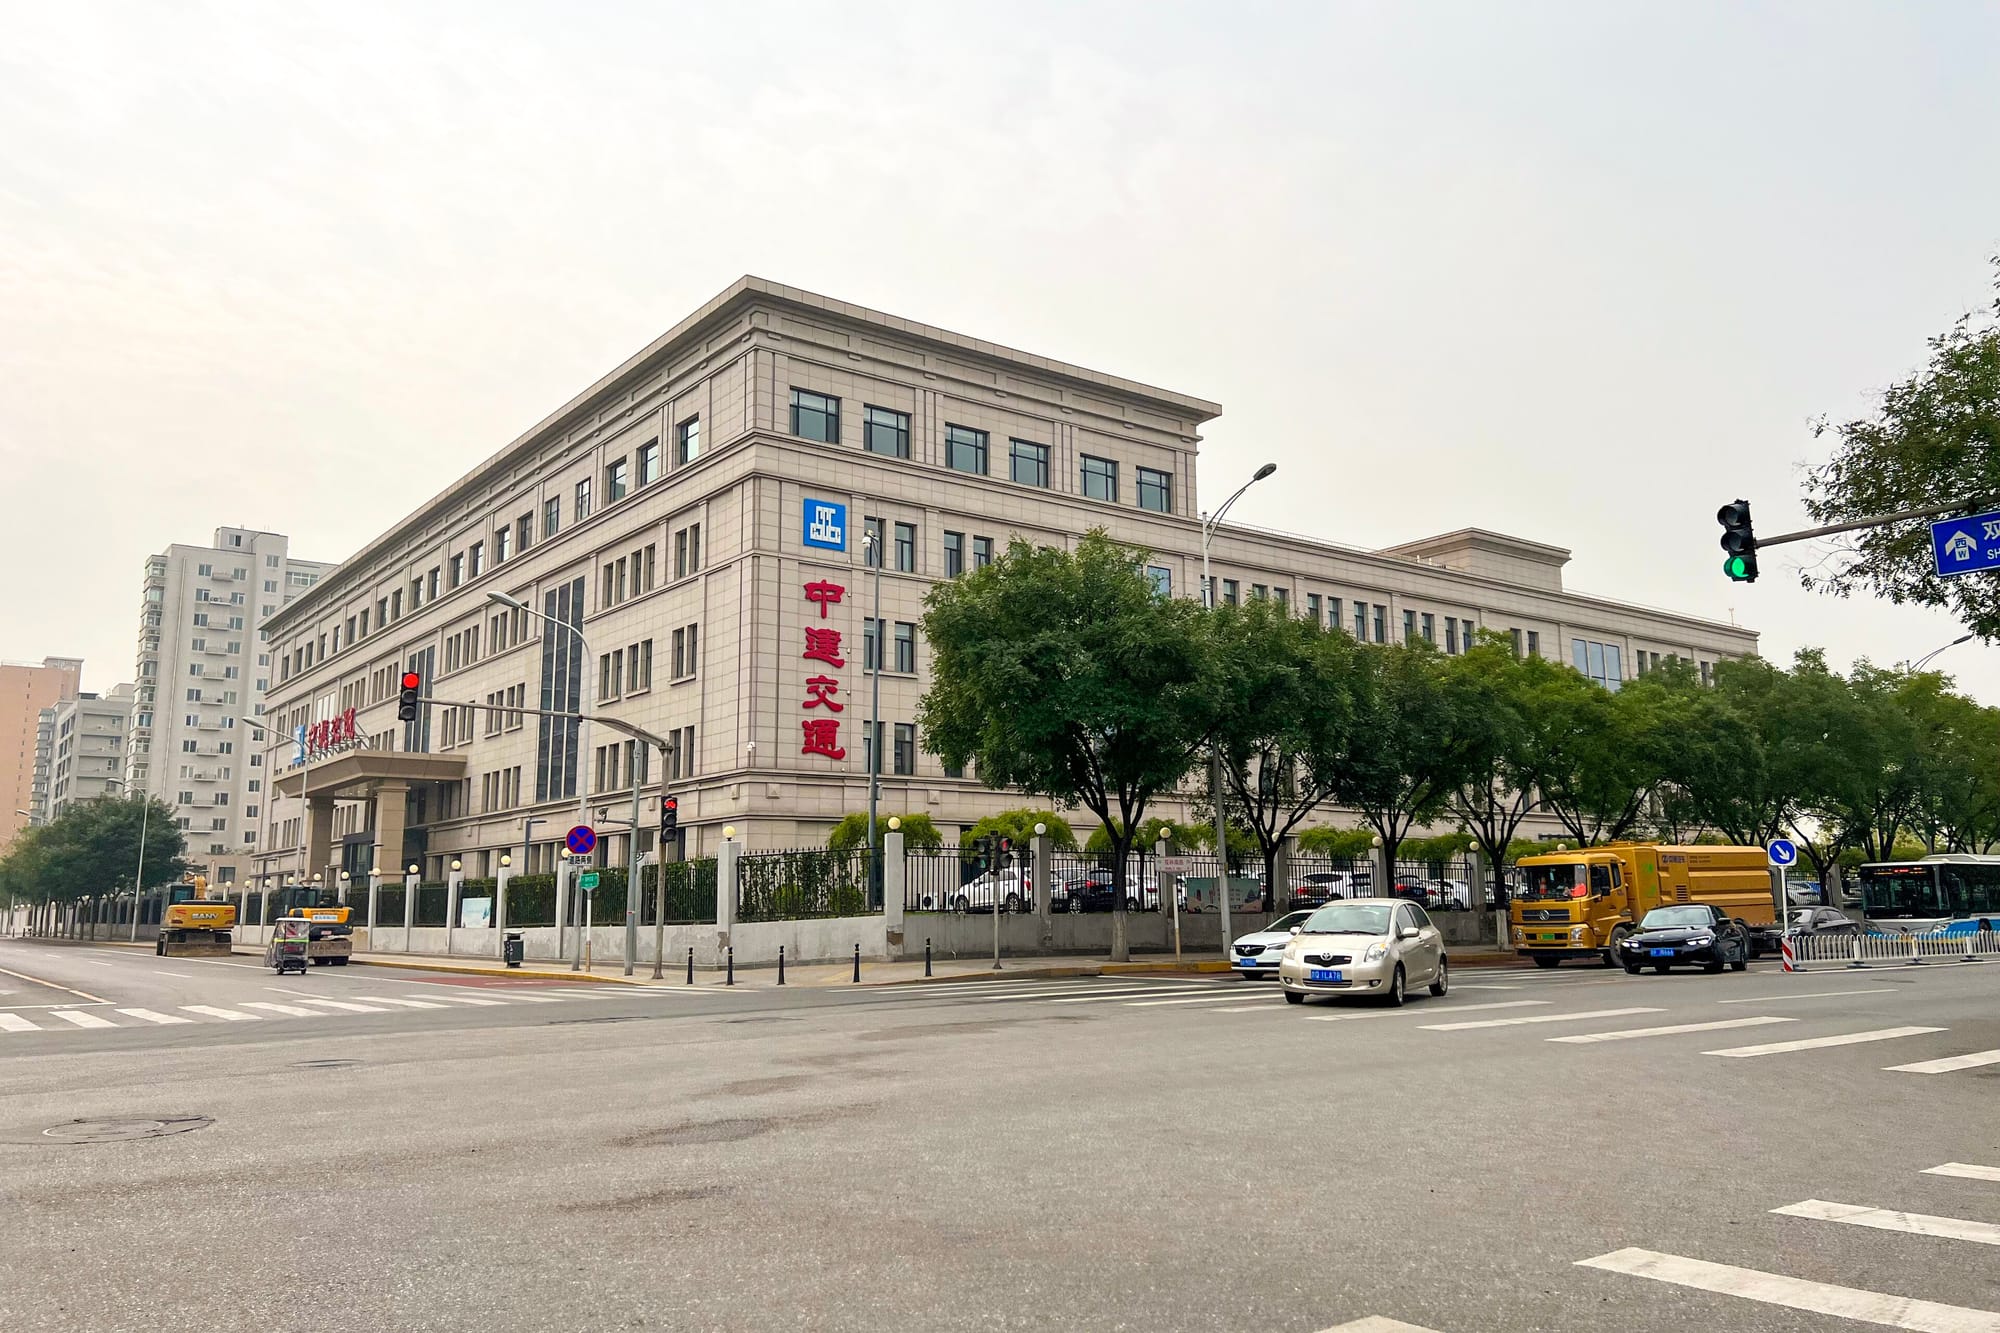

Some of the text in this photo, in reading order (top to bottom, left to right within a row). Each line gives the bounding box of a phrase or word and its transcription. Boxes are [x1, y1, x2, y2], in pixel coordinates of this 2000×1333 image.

[1958, 549, 1967, 559] W
[802, 579, 846, 760] 中建交通
[192, 912, 219, 920] SANY
